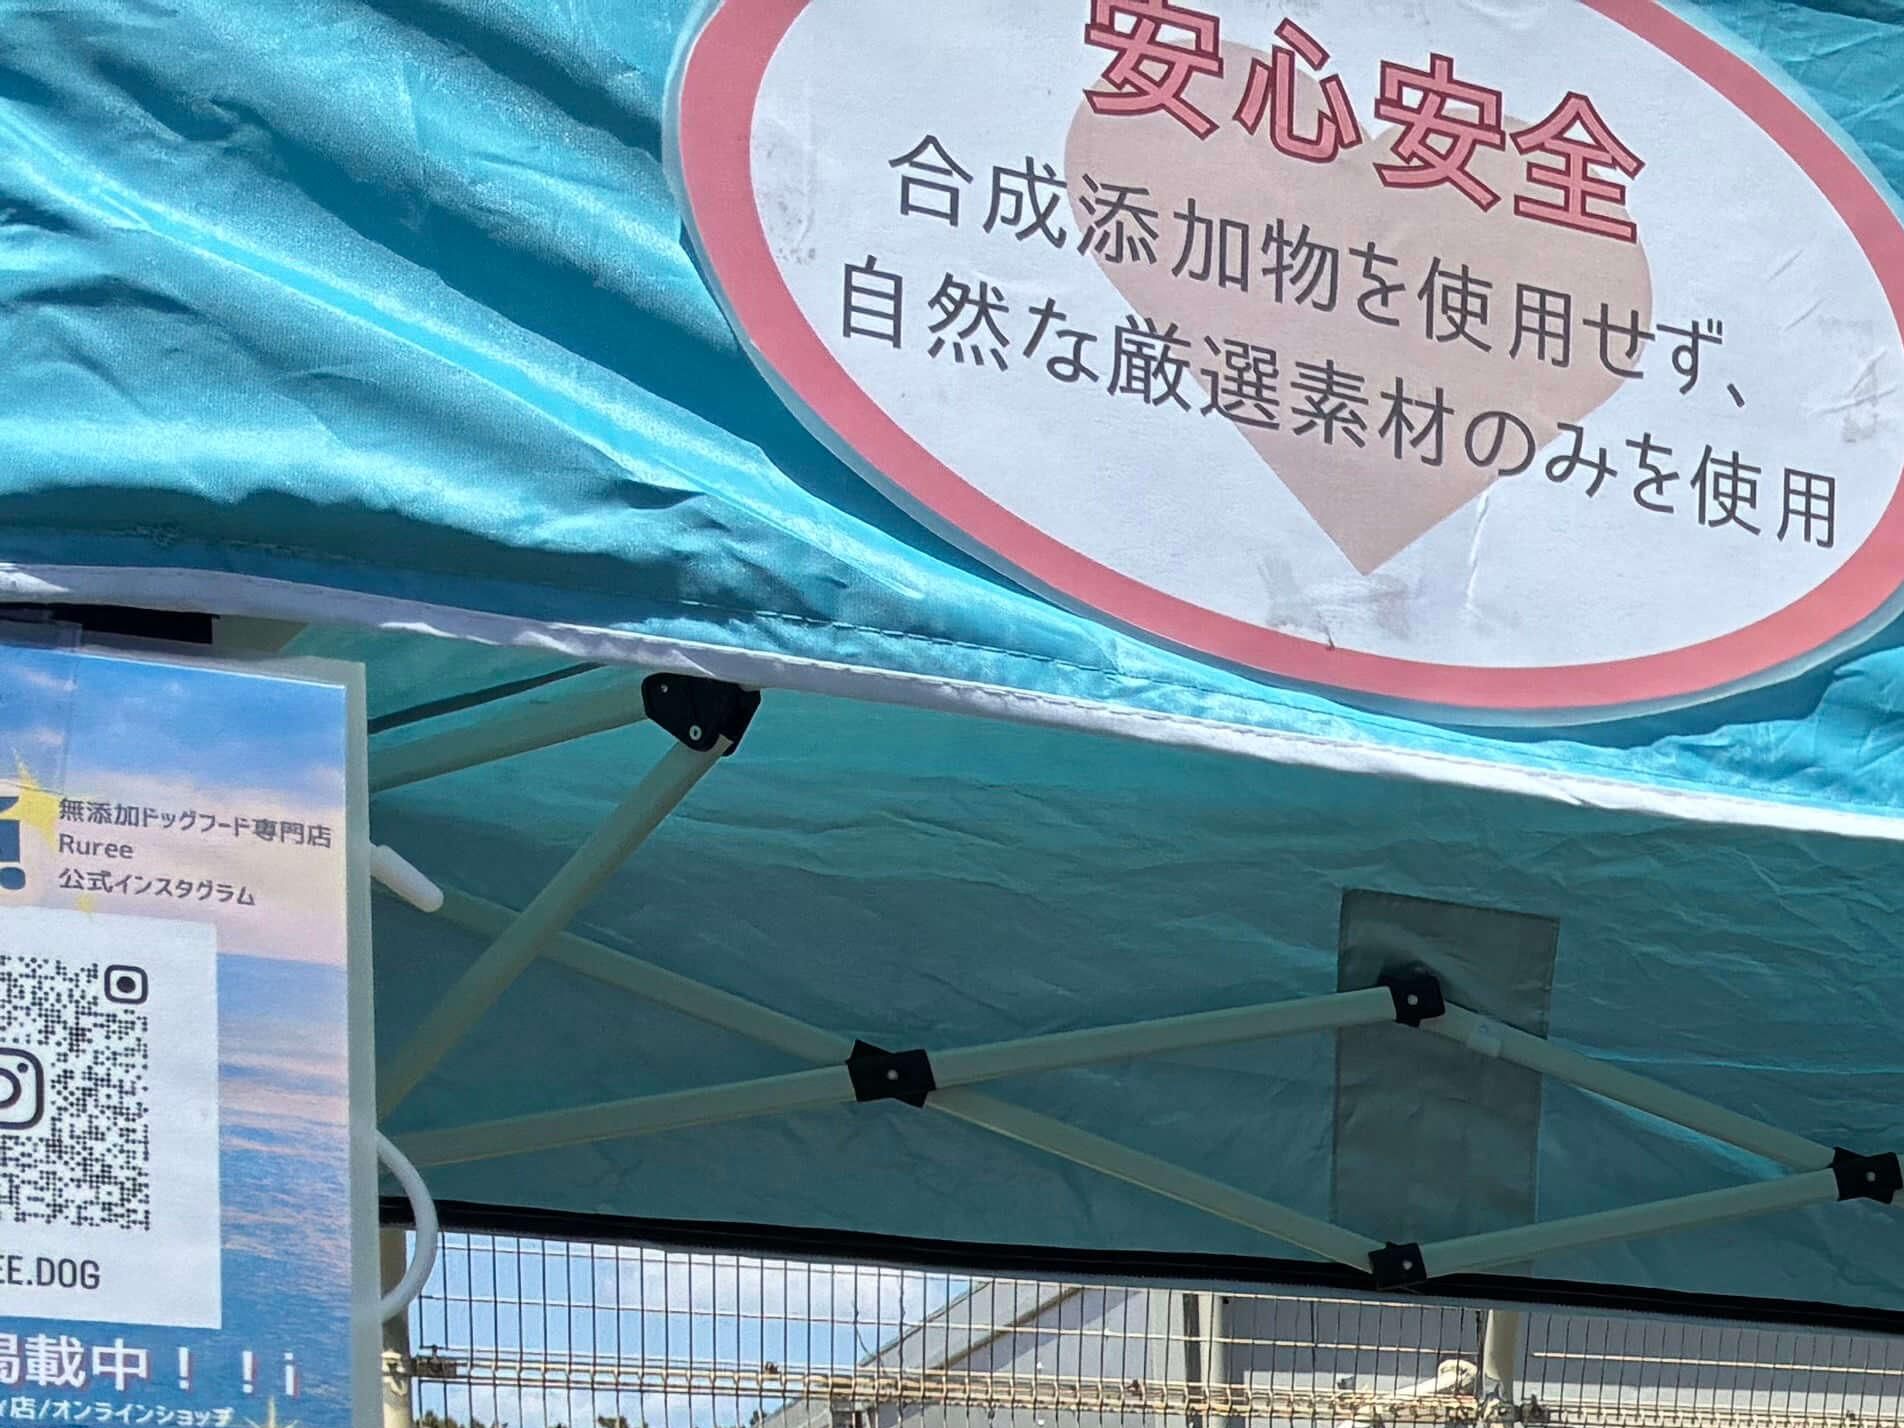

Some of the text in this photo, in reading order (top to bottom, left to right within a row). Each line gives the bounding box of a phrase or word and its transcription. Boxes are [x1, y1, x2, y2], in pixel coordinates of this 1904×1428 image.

[1083, 0, 1648, 246] 安心安全
[886, 133, 1750, 410] 合成添加物を使用せず、
[839, 258, 1841, 550] 自然な厳選素材のみを使用
[58, 798, 332, 849] 無添加ドッグフード専門店
[58, 835, 134, 859] Ruree
[58, 868, 255, 906] 公式インスタグラム
[0, 1396, 234, 1428] 店/オンラインショップ
